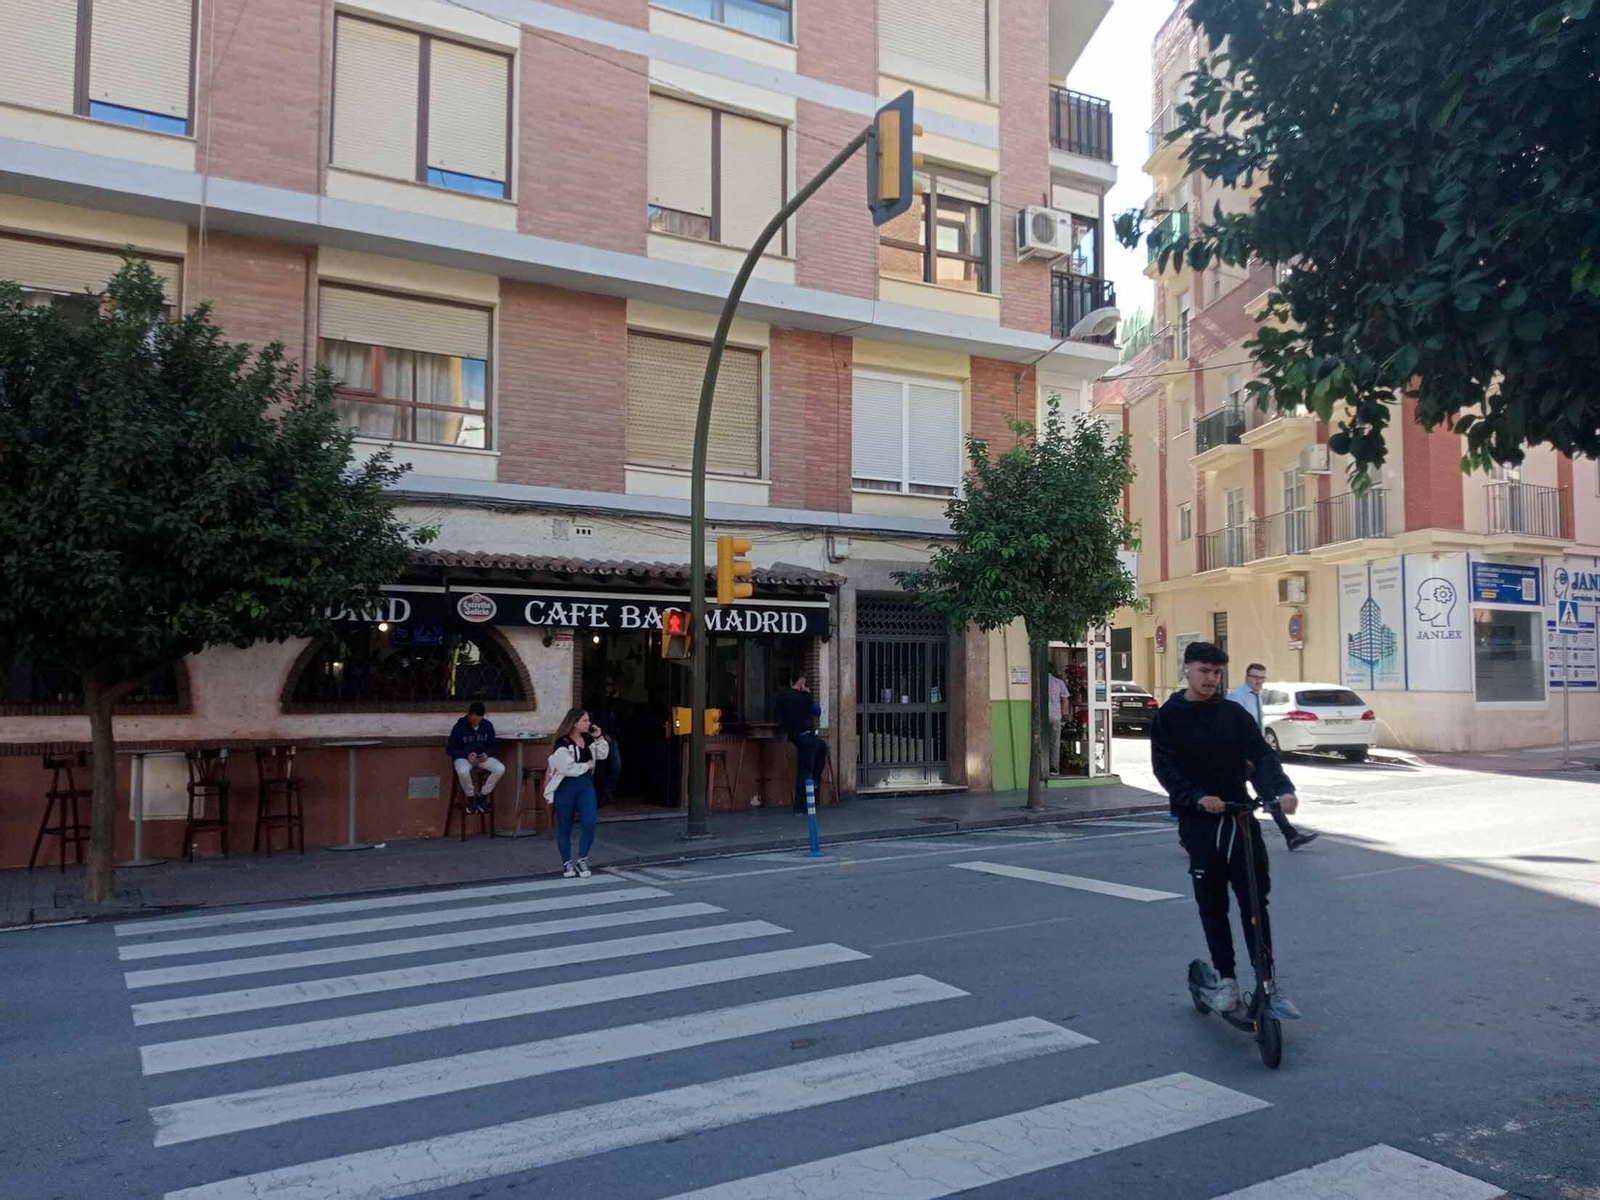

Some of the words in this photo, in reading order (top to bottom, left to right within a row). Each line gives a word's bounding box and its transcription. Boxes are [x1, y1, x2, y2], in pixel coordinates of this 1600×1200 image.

[1571, 572, 1600, 592] JAN
[310, 597, 412, 623] DRID
[524, 600, 610, 627] CAFE
[620, 605, 682, 629] BA
[704, 609, 808, 634] MADRID
[1416, 630, 1463, 640] JANLEX
